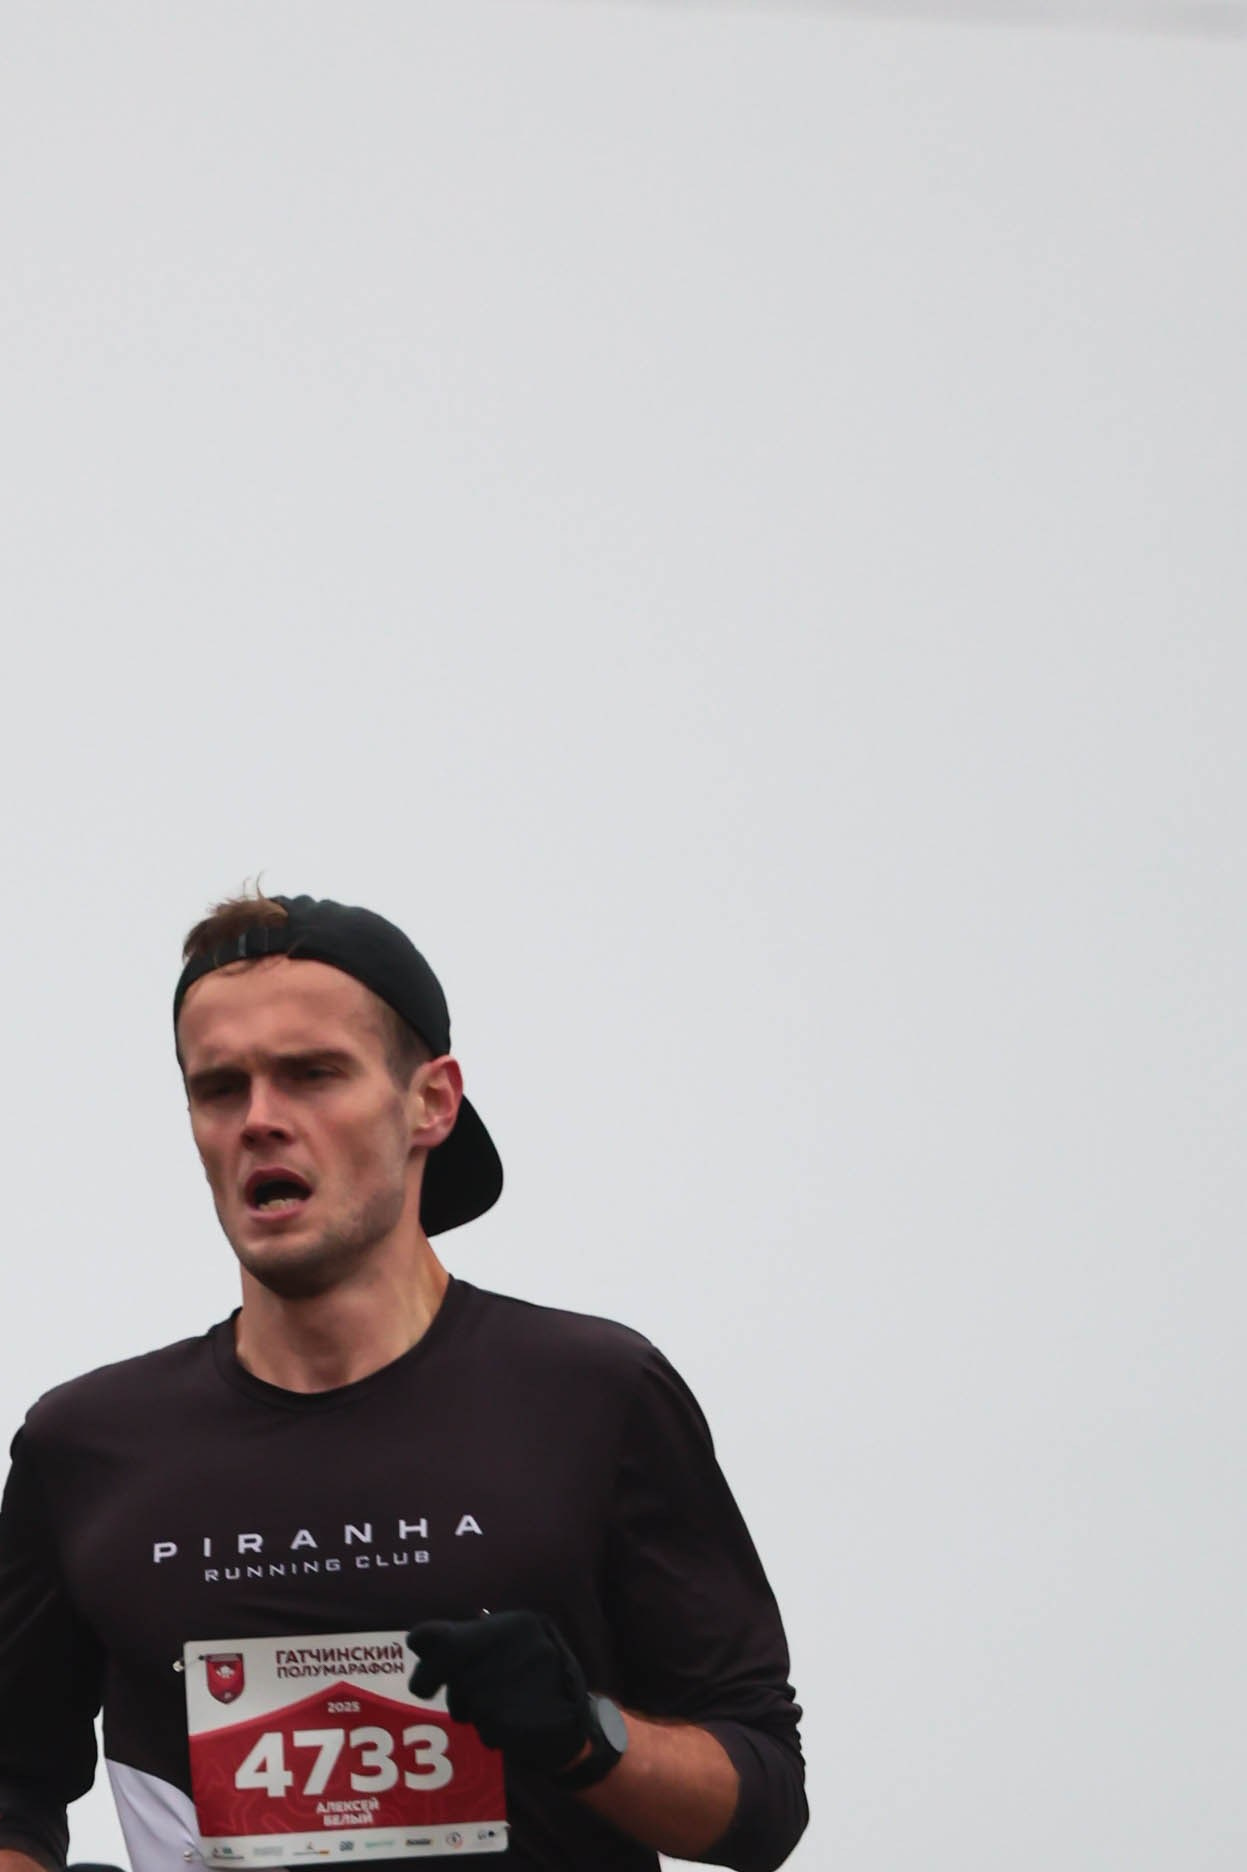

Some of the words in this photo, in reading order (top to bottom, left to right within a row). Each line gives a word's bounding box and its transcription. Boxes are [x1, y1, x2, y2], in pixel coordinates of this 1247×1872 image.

[153, 1514, 483, 1563] PIRANHA
[205, 1558, 341, 1582] RUNNING
[355, 1550, 430, 1569] CLUB
[276, 1641, 403, 1664] ГАТЧИНСКИЙ
[277, 1662, 405, 1678] ПОЛУМАРАФОН
[327, 1701, 361, 1713] 2025
[234, 1724, 453, 1798] 4733
[316, 1797, 380, 1814] АЛЕКСЕЙ
[323, 1811, 374, 1826] БЕЛЫЙ
